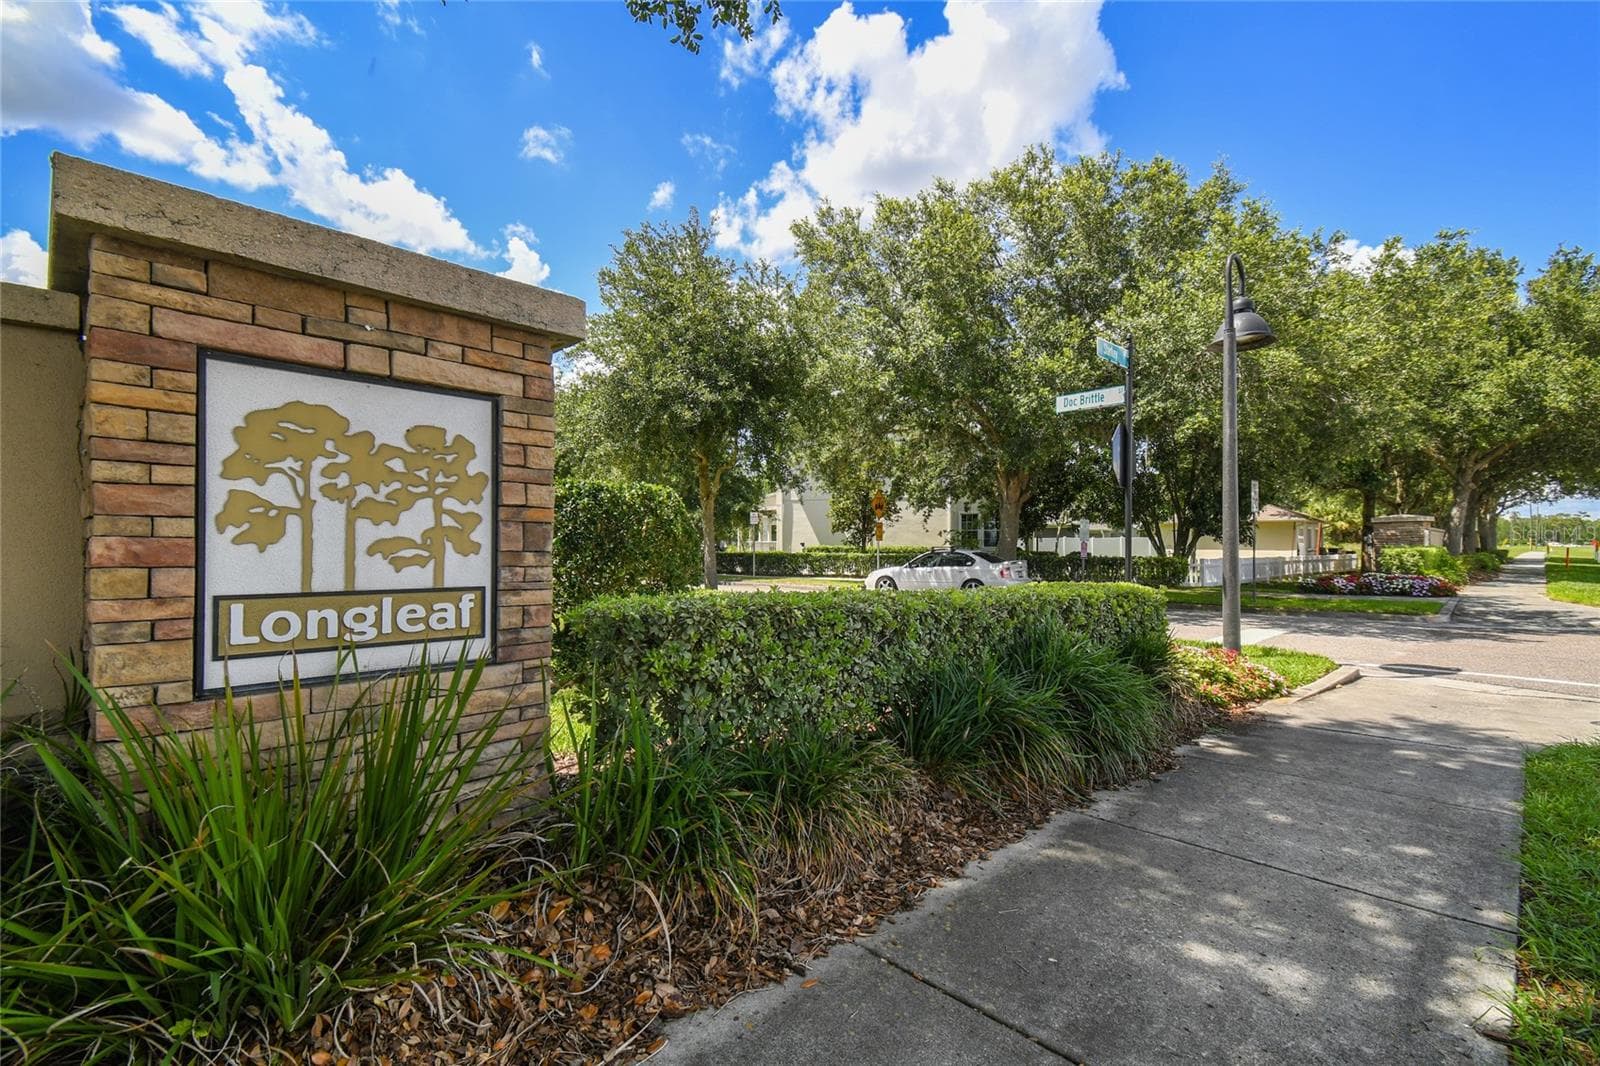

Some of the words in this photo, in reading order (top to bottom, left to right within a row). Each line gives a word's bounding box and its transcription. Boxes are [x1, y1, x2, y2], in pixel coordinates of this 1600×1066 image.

[1063, 397, 1077, 407] Doc
[1080, 392, 1104, 404] Brittle
[229, 593, 476, 646] Longleaf
